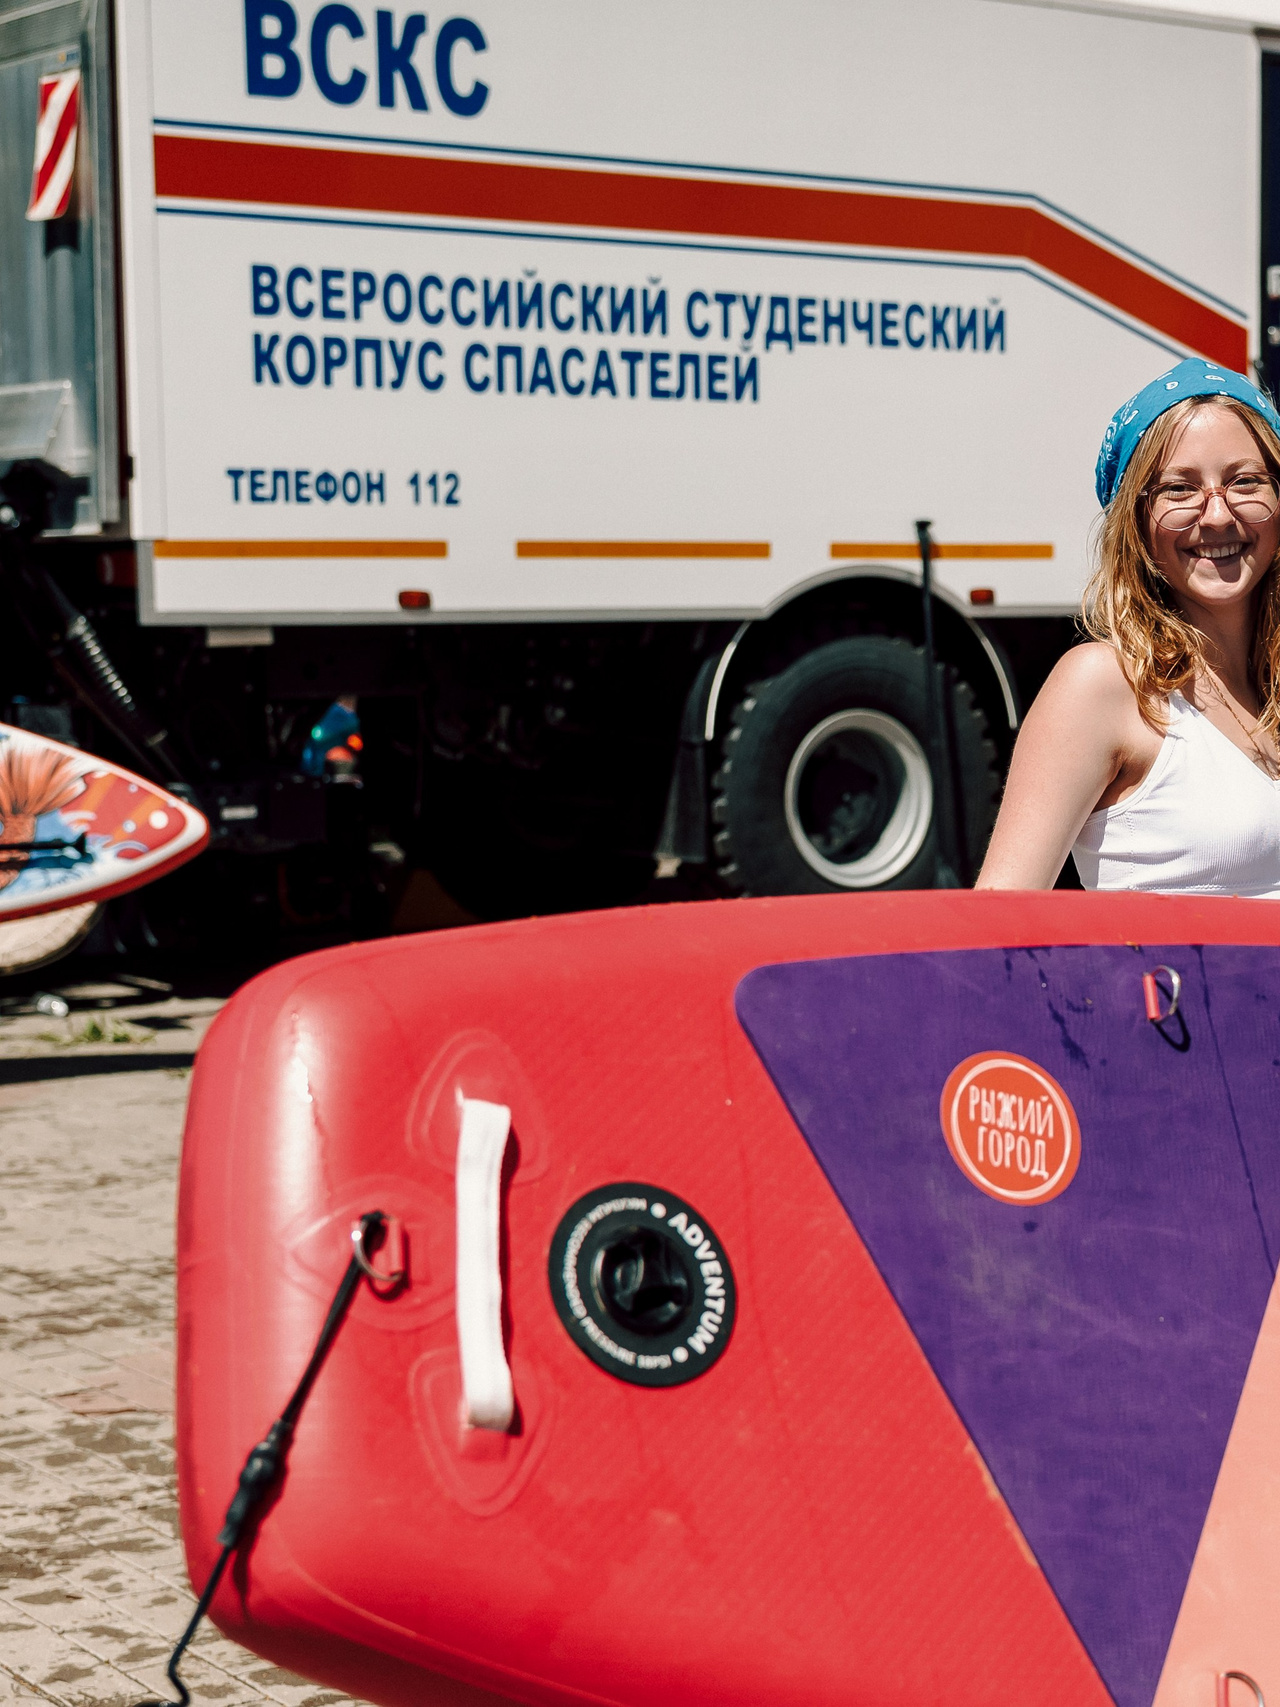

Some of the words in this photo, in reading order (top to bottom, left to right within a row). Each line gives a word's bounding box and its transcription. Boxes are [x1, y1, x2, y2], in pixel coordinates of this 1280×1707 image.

[244, 0, 490, 118] ВСКС
[250, 264, 668, 337] ВСЕРОССИЙСКИЙ
[686, 291, 1006, 352] СТУДЕНЧЕСКИЙ
[254, 332, 446, 394] КОРПУС
[463, 343, 759, 402] СПАСАТЕЛЕЙ
[227, 468, 385, 504] ТЕЛЕФОН
[409, 473, 460, 505] 112
[968, 1084, 1054, 1139] РЫЖИЙ
[977, 1125, 1049, 1181] ГОРОД
[667, 1212, 726, 1355] ADVENTUM
